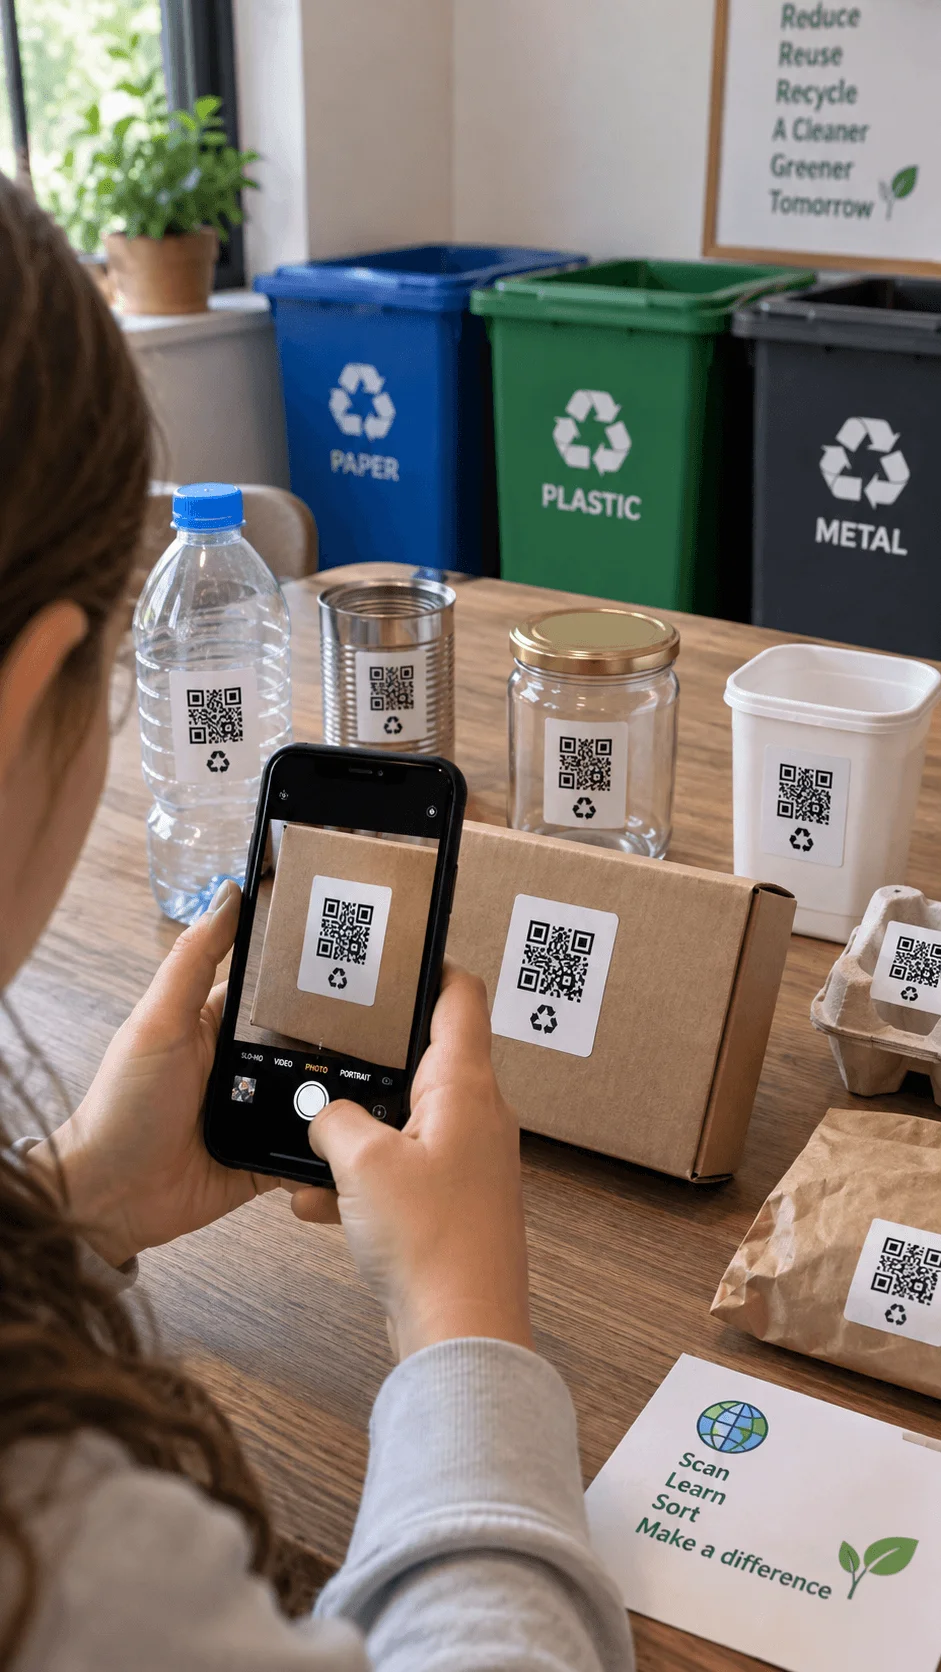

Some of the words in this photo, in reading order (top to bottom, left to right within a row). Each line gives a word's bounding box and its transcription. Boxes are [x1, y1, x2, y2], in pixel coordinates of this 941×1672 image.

[780, 2, 861, 30] Reduce
[778, 40, 843, 67] Reuse
[775, 77, 857, 112] Recycle
[772, 117, 787, 141] A
[792, 116, 869, 143] Cleaner
[770, 153, 854, 180] Greener
[769, 188, 874, 219] Tomorrow
[330, 449, 399, 482] PAPER
[541, 483, 641, 520] PLASTIC
[815, 516, 908, 555] METAL
[274, 1058, 293, 1067] VIDEO
[305, 1063, 328, 1074] PHOTO
[340, 1069, 371, 1081] PORTRAIT
[678, 1452, 730, 1481] Scan
[665, 1471, 726, 1505] Learn
[651, 1494, 700, 1523] Sort
[635, 1517, 696, 1551] Make
[700, 1544, 715, 1559] a
[720, 1549, 832, 1600] difference
